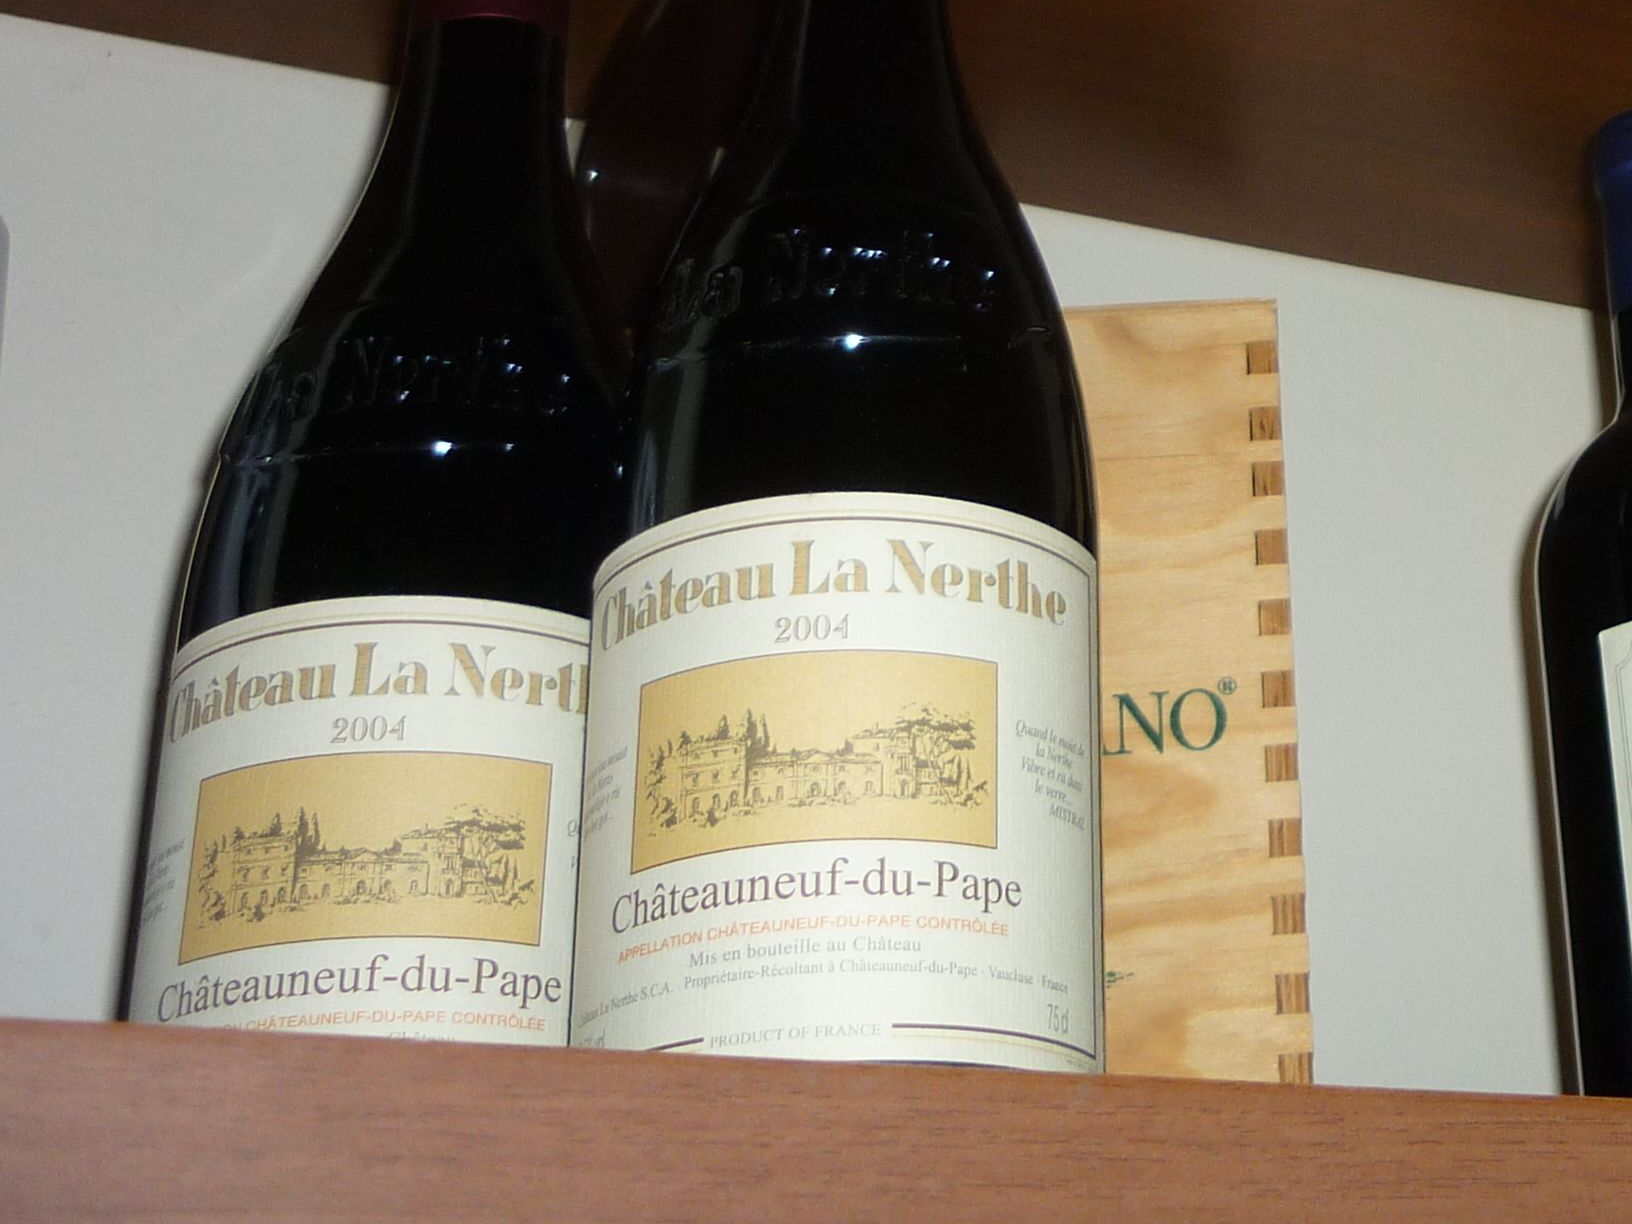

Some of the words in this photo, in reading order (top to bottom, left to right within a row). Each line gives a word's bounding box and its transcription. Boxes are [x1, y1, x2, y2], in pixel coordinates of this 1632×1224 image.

[600, 561, 776, 652] Château
[789, 538, 871, 598] La
[886, 538, 1069, 627] Nerthe
[774, 613, 850, 645] 2004
[168, 662, 337, 745] Château
[349, 641, 429, 698] La
[330, 714, 407, 745] 2004
[612, 856, 1023, 934] Châteauneuf-du-Pape
[617, 931, 703, 965] APPELLATION
[707, 914, 911, 942] CHÂTEAUNEUF-DU-PAPE
[916, 913, 1010, 937] CONTRÔLÉE
[689, 953, 717, 969] Mis
[723, 949, 742, 962] en
[747, 938, 821, 958] bouteille
[827, 940, 846, 953] au
[853, 936, 922, 953] Château
[157, 953, 563, 1024] Châteauneuf-du-Pape
[684, 961, 823, 990] Propriétaire-Récoltant
[839, 957, 978, 978] Châteauneuf-du-Pape
[988, 964, 1034, 985] Vaucluse
[452, 1009, 548, 1032] CONTRÔLÉE
[709, 1027, 784, 1049] PRODUCT
[788, 1026, 810, 1039] OF
[815, 1023, 882, 1039] FRANCE
